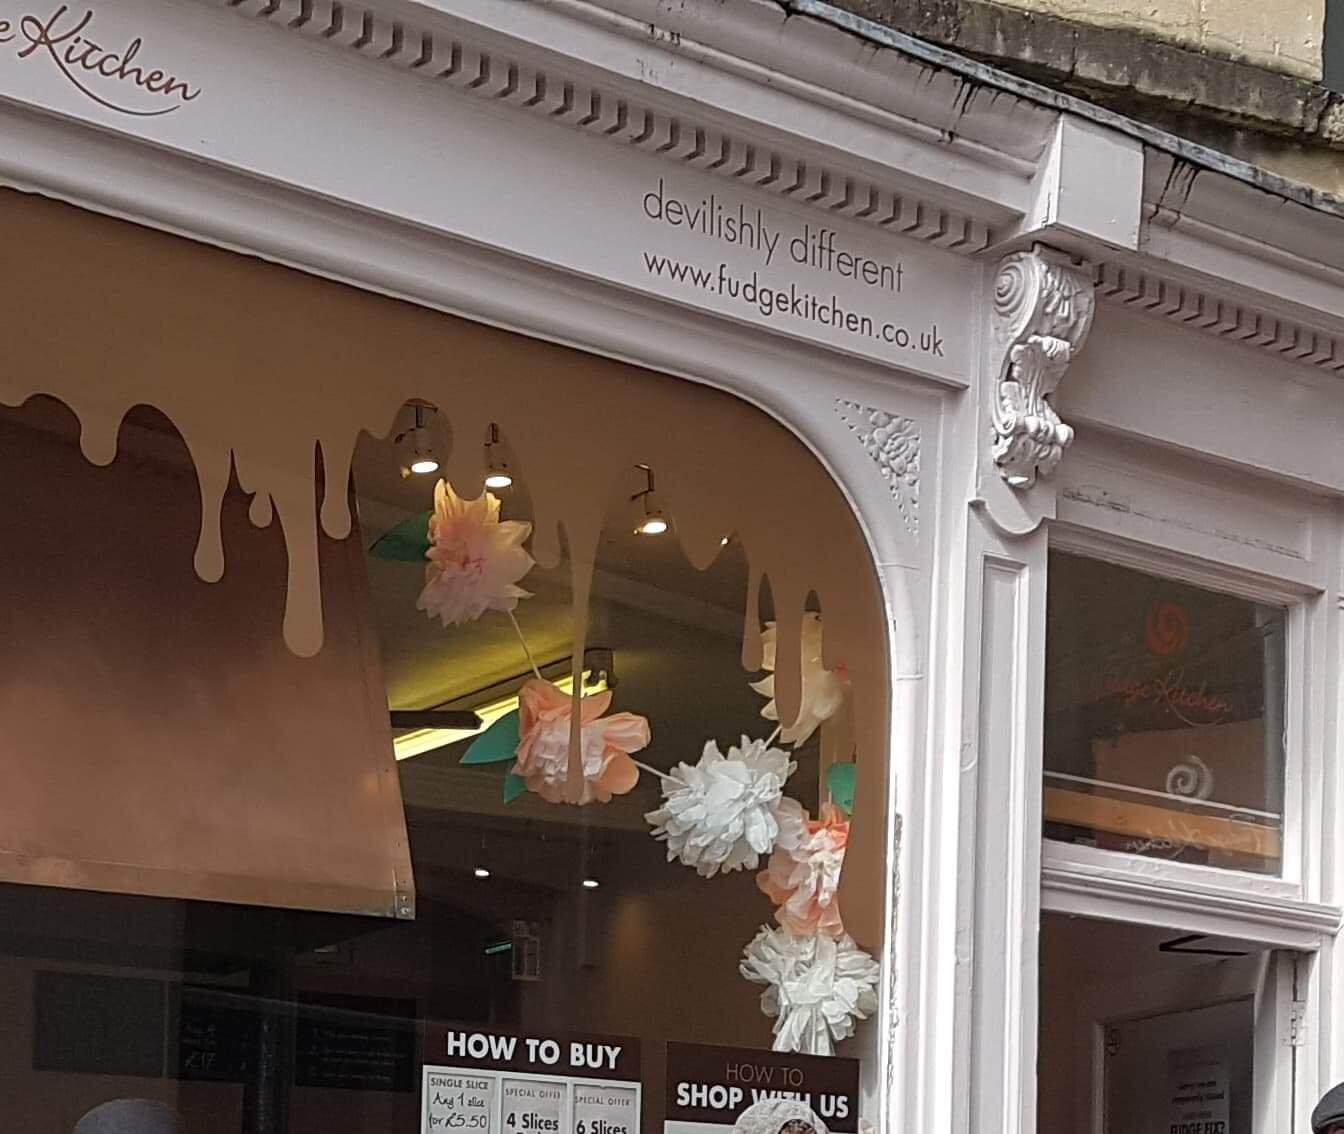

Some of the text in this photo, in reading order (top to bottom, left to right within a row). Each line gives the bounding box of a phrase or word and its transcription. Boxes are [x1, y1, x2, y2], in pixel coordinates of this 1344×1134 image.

[17, 4, 201, 116] Kitchen
[643, 178, 904, 292] devilishly different
[643, 252, 944, 357] www.fudgekitchen.co.uk
[447, 1031, 622, 1069] HOW TO BUY
[431, 1077, 488, 1090] SINGLE SLICE
[726, 1063, 803, 1087] HOW TO
[432, 1091, 454, 1109] Any
[457, 1092, 464, 1106] 1
[505, 1088, 535, 1098] SPECIAL
[575, 1096, 630, 1106] SPECIAL OFFER
[676, 1082, 743, 1109] SHOP
[820, 1094, 849, 1118] US
[506, 1112, 559, 1131] 4 Slices
[576, 1120, 586, 1134] 6
